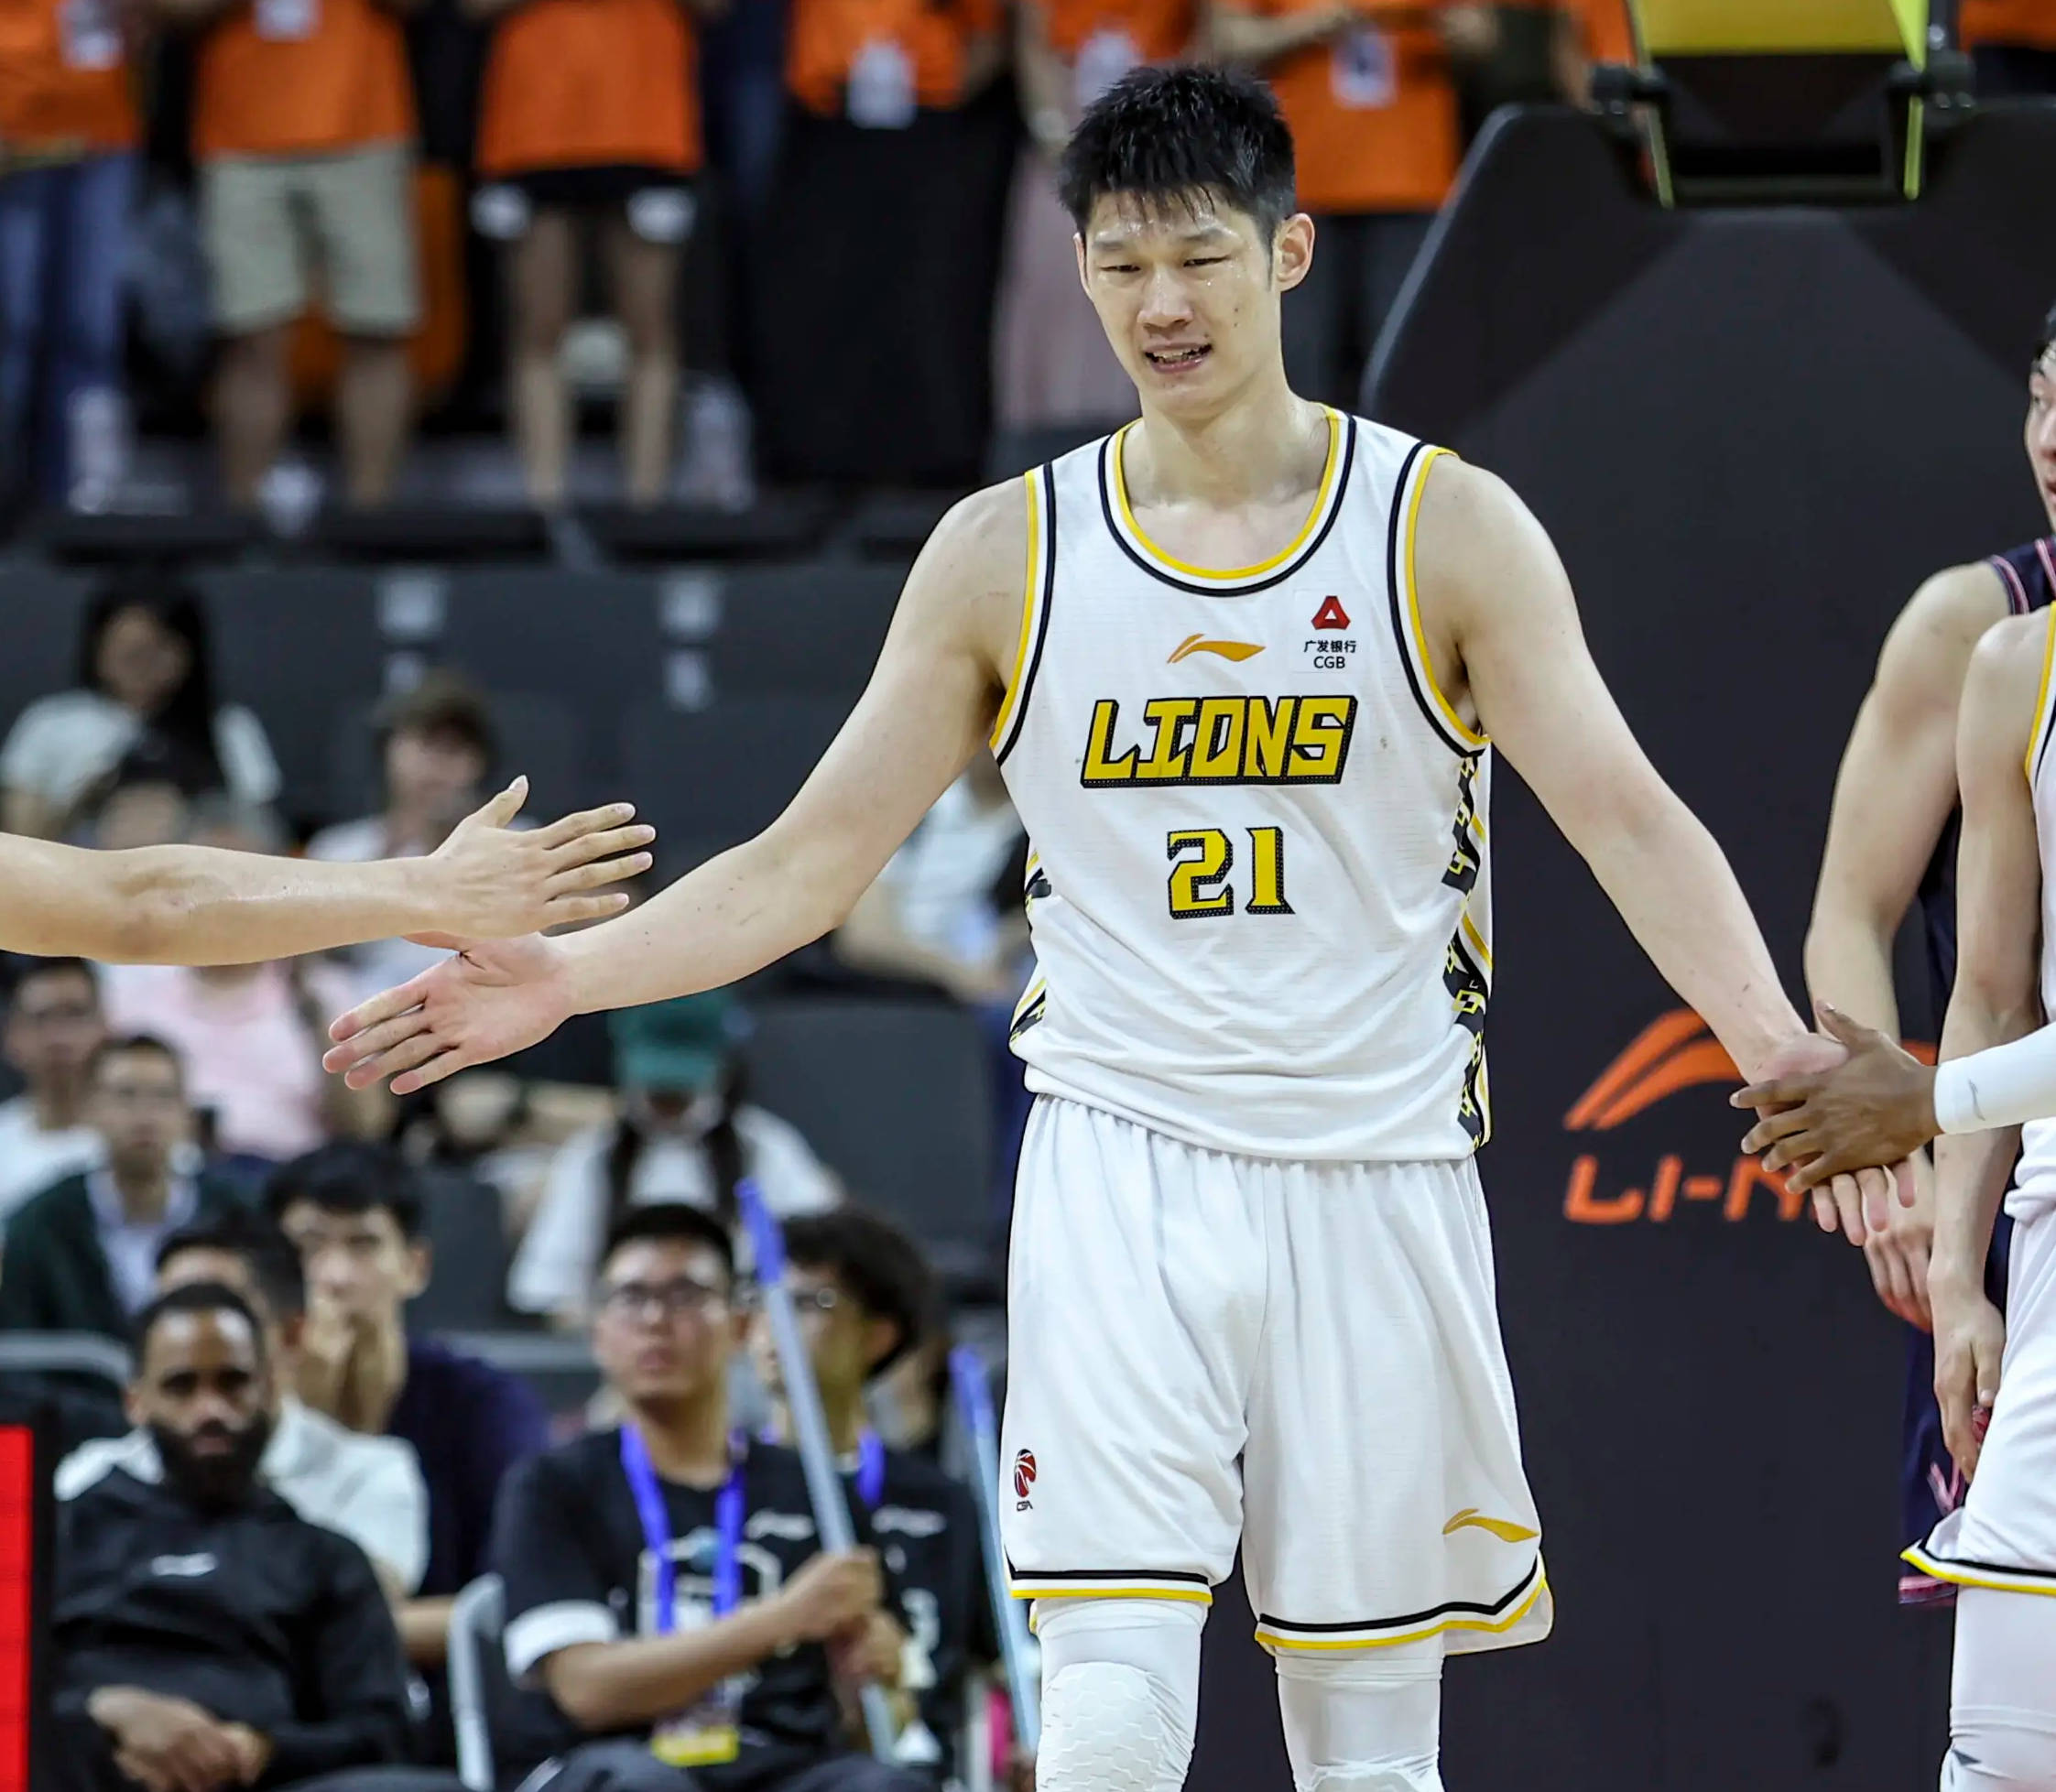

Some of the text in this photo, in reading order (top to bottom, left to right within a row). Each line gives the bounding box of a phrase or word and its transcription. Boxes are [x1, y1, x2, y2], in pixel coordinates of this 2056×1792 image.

[1303, 639, 1357, 653] 广发银行
[1313, 656, 1346, 669] CGB
[1080, 695, 1358, 788] LIONS
[1167, 826, 1296, 919] 21
[1564, 1155, 1817, 1222] LI-N
